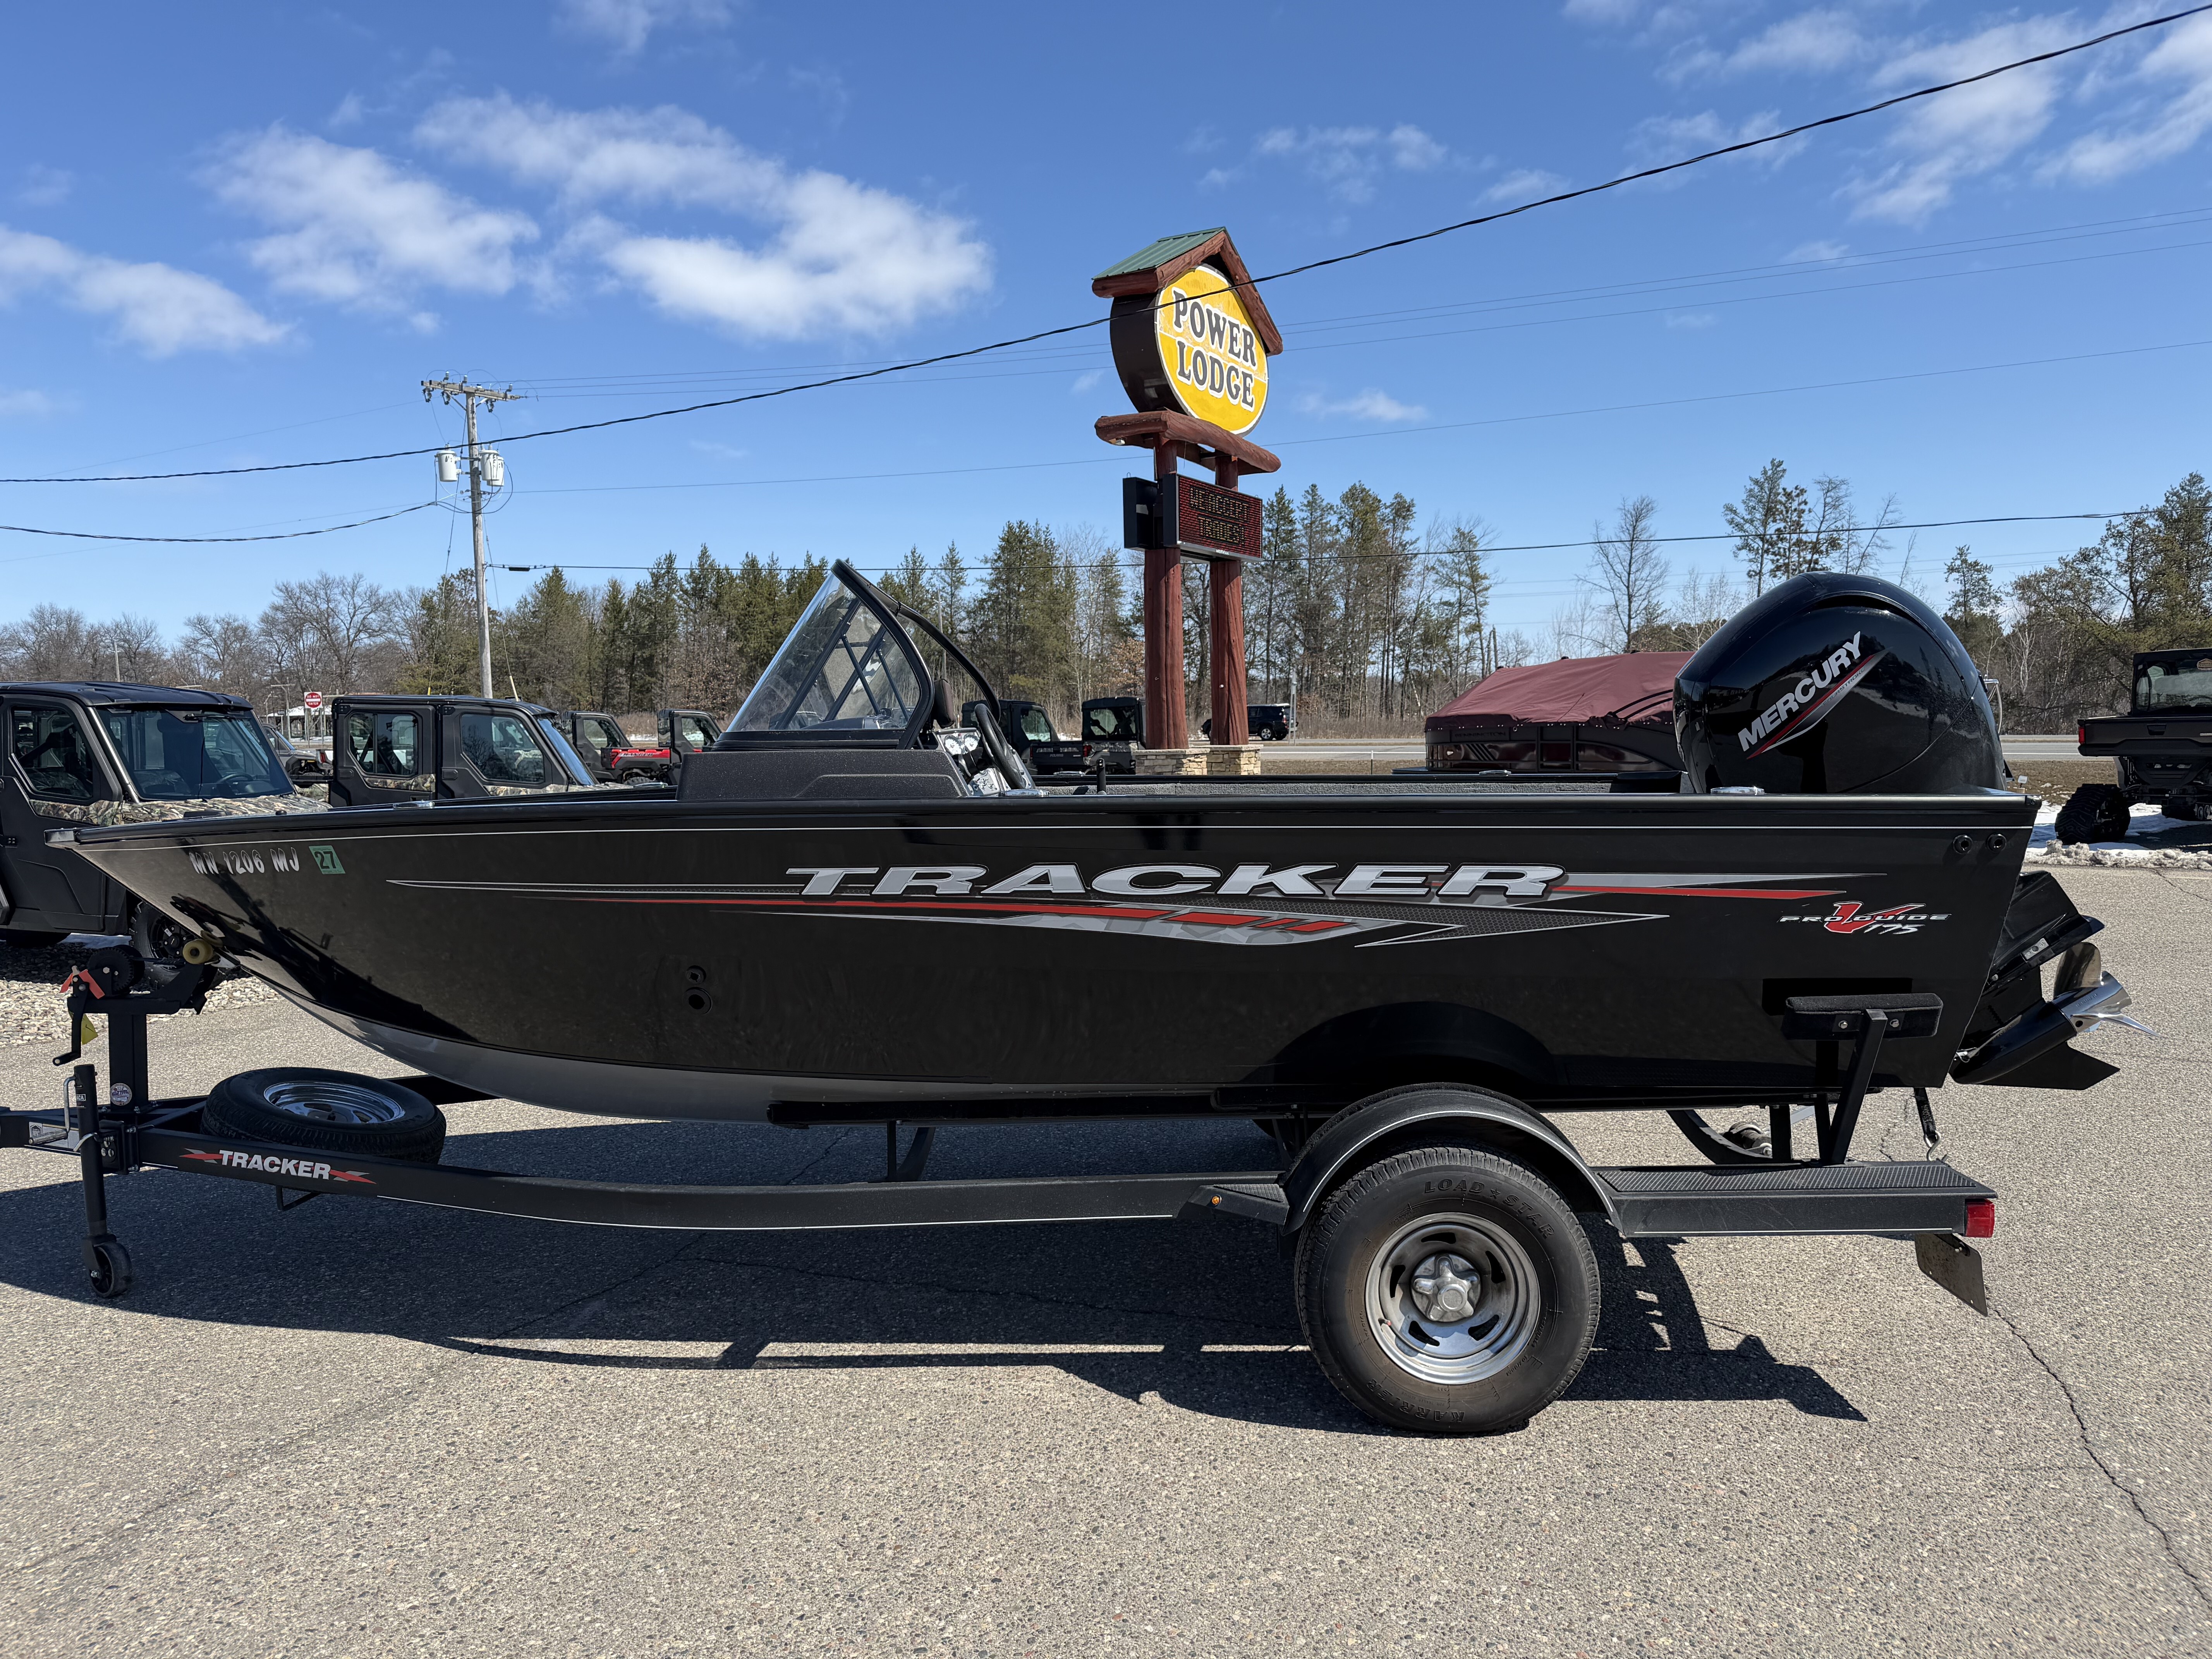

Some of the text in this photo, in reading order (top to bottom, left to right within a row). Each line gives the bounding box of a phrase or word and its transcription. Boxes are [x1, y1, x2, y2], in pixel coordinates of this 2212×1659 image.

[1172, 288, 1257, 368] POWER
[1176, 340, 1254, 409] LODGE
[1738, 631, 1862, 751] MERCURY
[1822, 667, 1865, 706] FOURSTROKE
[189, 847, 300, 874] MN 1206 MJ
[314, 851, 337, 869] 27
[786, 864, 1565, 896] TRACKER
[1863, 924, 1925, 935] 175
[219, 1149, 331, 1181] TRACKER
[1424, 1178, 1555, 1239] LOAD STAR
[1366, 1379, 1465, 1423] KARRIER
